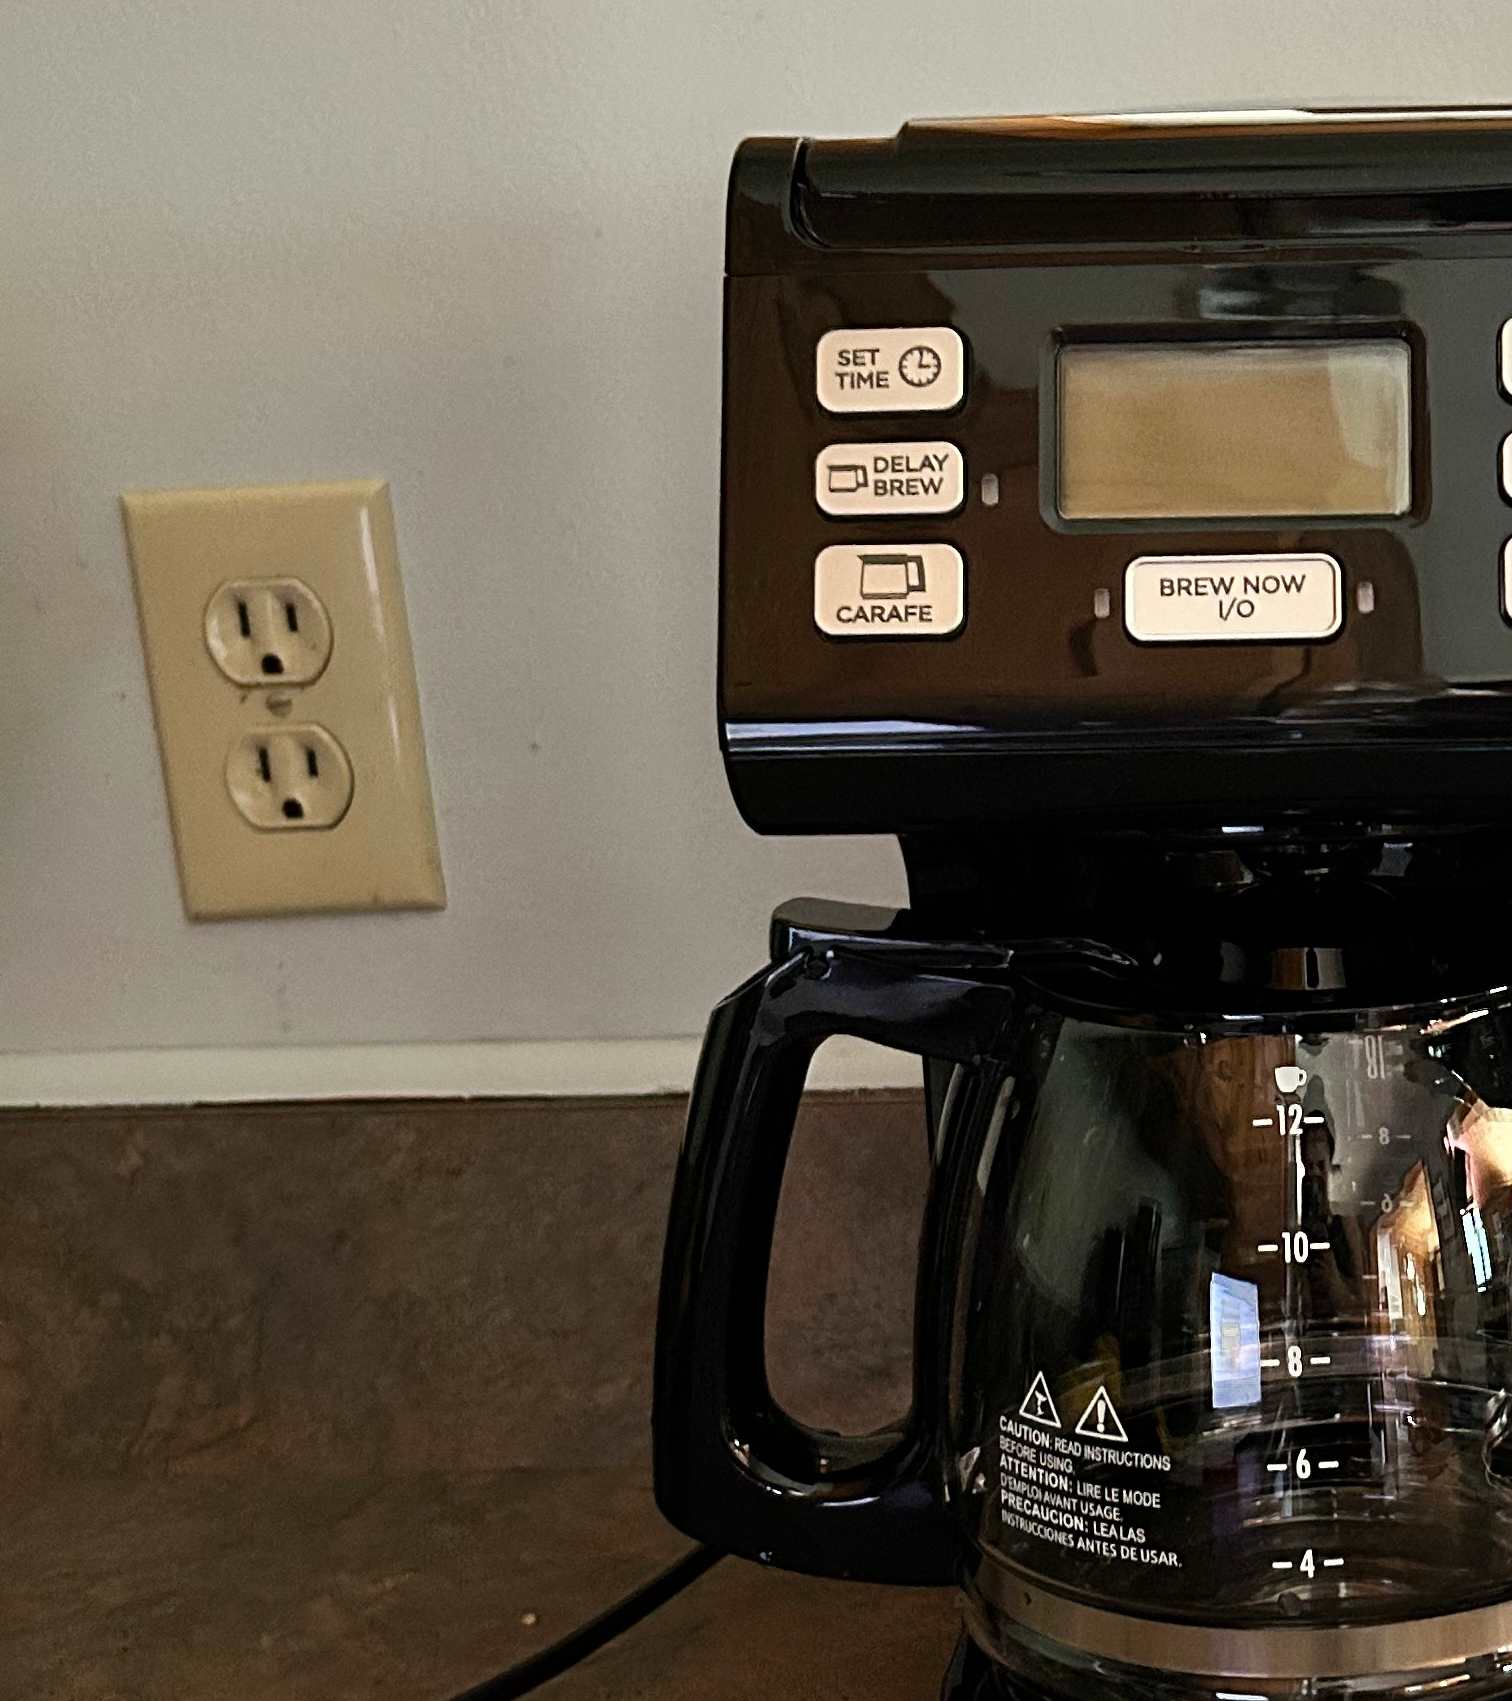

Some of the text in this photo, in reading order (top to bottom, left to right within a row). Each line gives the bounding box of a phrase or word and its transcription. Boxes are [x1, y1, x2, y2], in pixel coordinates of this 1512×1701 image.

[837, 348, 881, 368] SET
[835, 370, 890, 391] TIME
[873, 453, 949, 474] DELAY
[873, 476, 944, 497] BREW
[1159, 573, 1306, 598] BREW NOW
[836, 604, 933, 625] CARAFE
[1218, 599, 1256, 621] I/O
[1000, 1415, 1171, 1471] CAUTION: READ INSTRUCTIONS
[1000, 1435, 1036, 1463] BEFORE
[1000, 1453, 1161, 1509] ATTENTION: LIRE LE MODE
[1000, 1472, 1043, 1501] D'EMPLOI
[1044, 1490, 1078, 1512] AVANT
[1001, 1489, 1146, 1544] PRECAUCION: LEA LAS
[1001, 1508, 1183, 1568] INSTRUCCIONES ANTES DE USAR.
